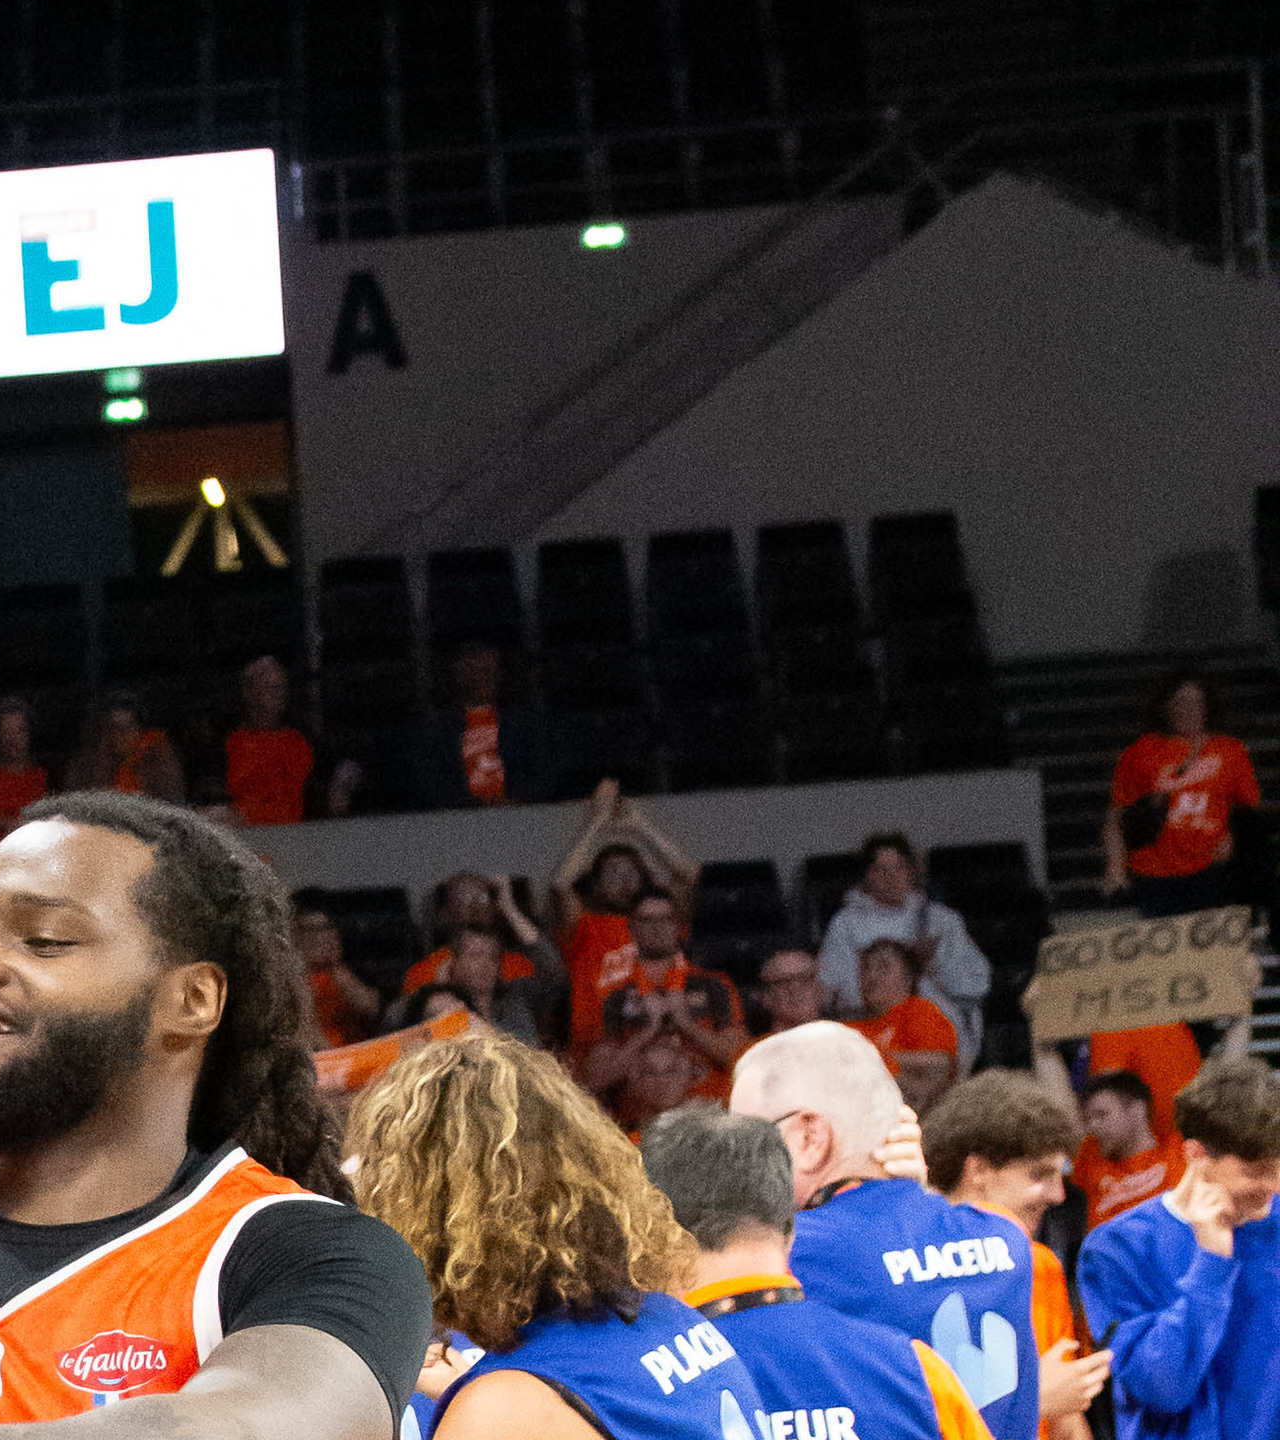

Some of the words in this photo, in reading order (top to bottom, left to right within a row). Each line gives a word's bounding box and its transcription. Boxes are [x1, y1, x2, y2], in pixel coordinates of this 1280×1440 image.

[18, 198, 178, 336] EJ
[326, 270, 408, 375] A
[1110, 922, 1179, 962] GO
[882, 1236, 1016, 1285] PLACEUR
[73, 1343, 168, 1381] Gaulois
